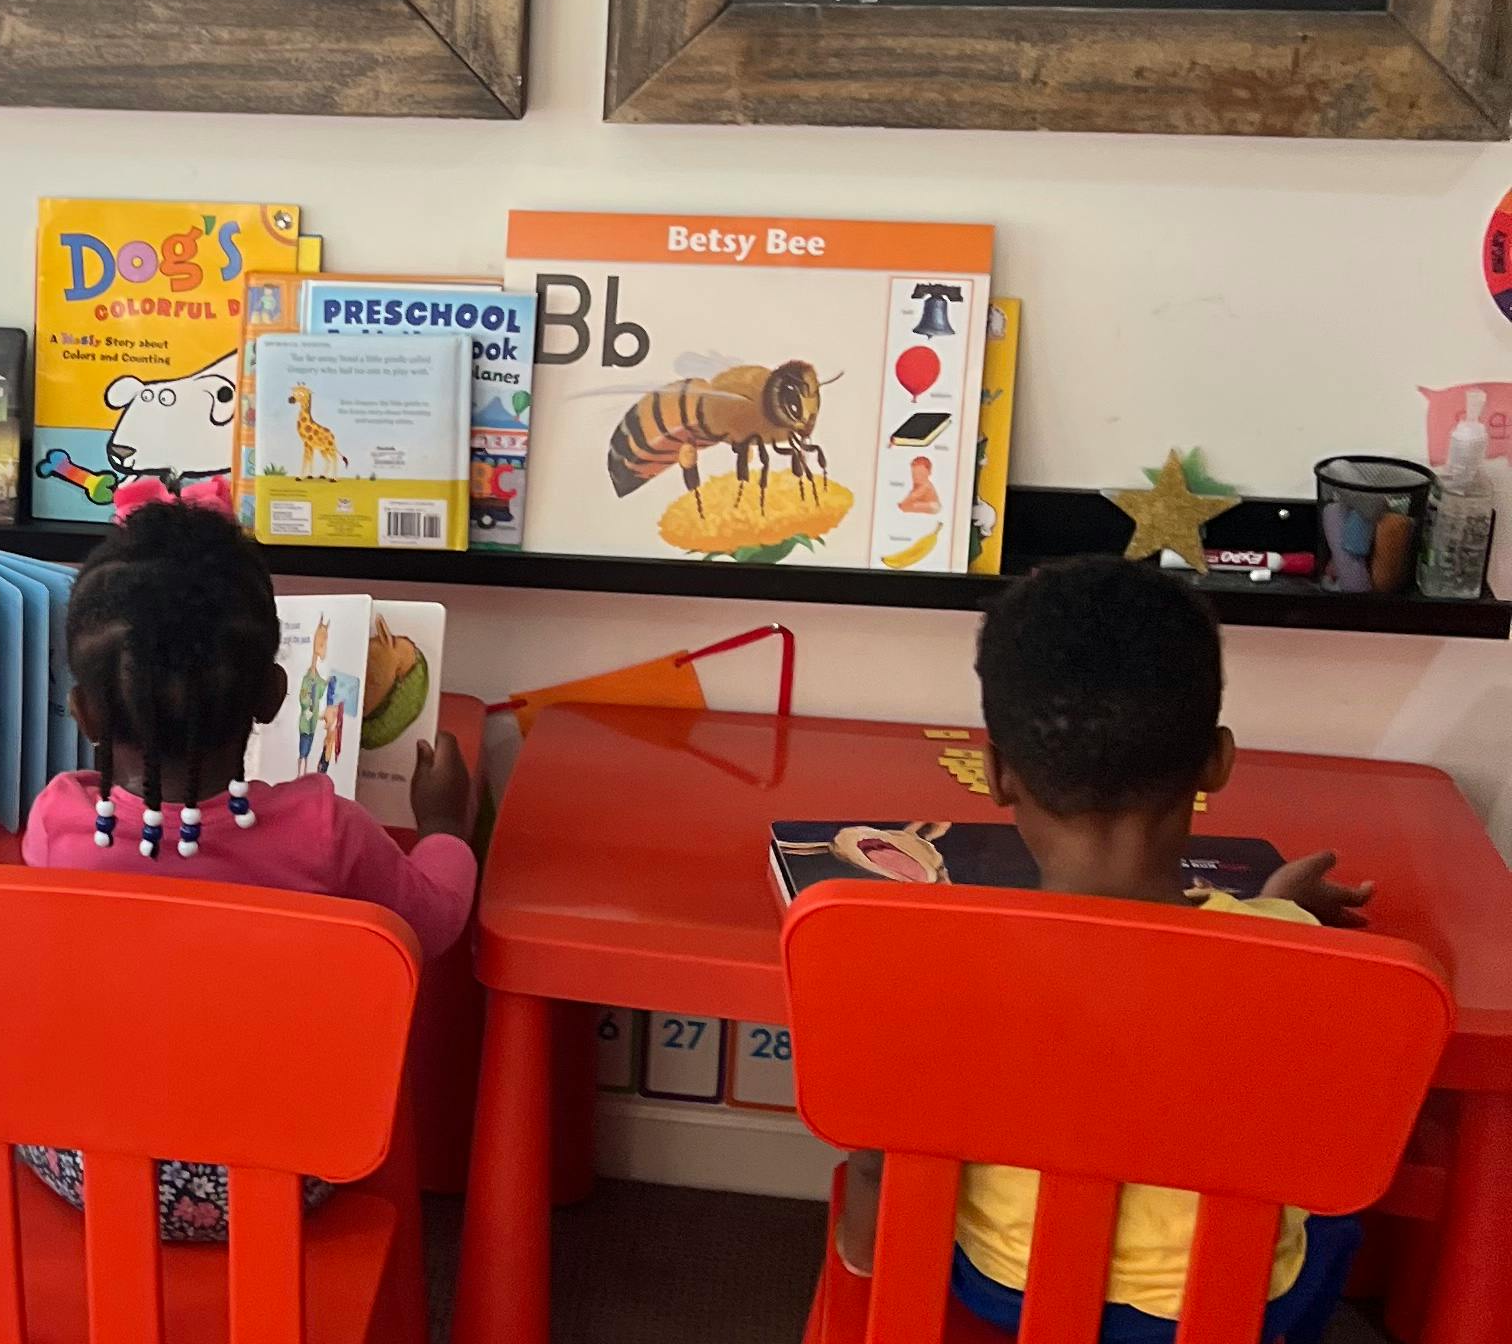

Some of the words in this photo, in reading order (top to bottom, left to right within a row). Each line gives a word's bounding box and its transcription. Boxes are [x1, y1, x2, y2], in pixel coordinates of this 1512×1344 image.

[667, 225, 756, 262] Betsy
[767, 228, 826, 256] Bee
[94, 297, 217, 322] COLORFUL
[323, 299, 521, 333] PRESCHOOL
[534, 273, 651, 369] Bb
[50, 335, 58, 344] A
[105, 336, 135, 349] Story
[139, 338, 169, 350] about
[63, 350, 96, 361] Colors
[100, 352, 118, 362] and
[122, 353, 170, 367] Counting
[663, 1019, 707, 1050] 27
[750, 1029, 792, 1060] 28
